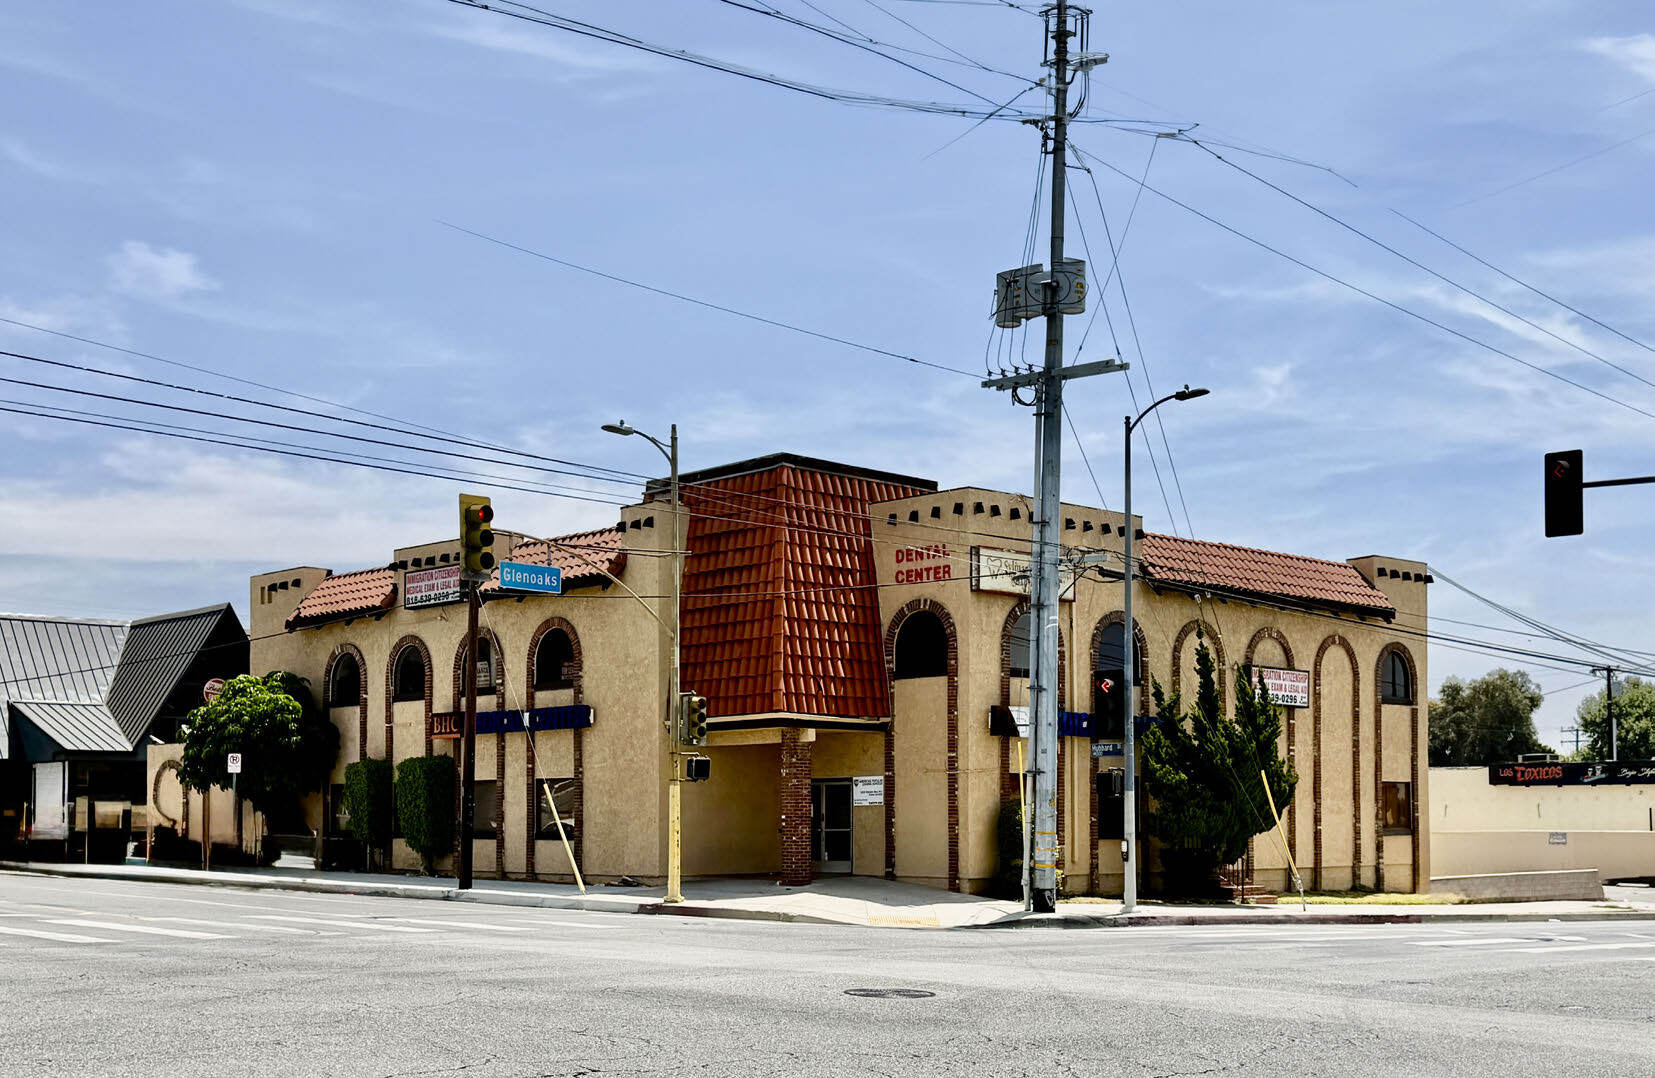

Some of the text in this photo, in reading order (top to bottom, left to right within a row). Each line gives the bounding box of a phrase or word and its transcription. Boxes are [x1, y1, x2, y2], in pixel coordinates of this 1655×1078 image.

[896, 543, 951, 564] DENTAL
[503, 567, 558, 587] Glenoaks
[895, 565, 952, 584] CENTER
[433, 715, 458, 734] BHC
[476, 710, 524, 733] EDICAL
[1500, 768, 1514, 777] LOS
[1514, 766, 1563, 781] TOXICOS
